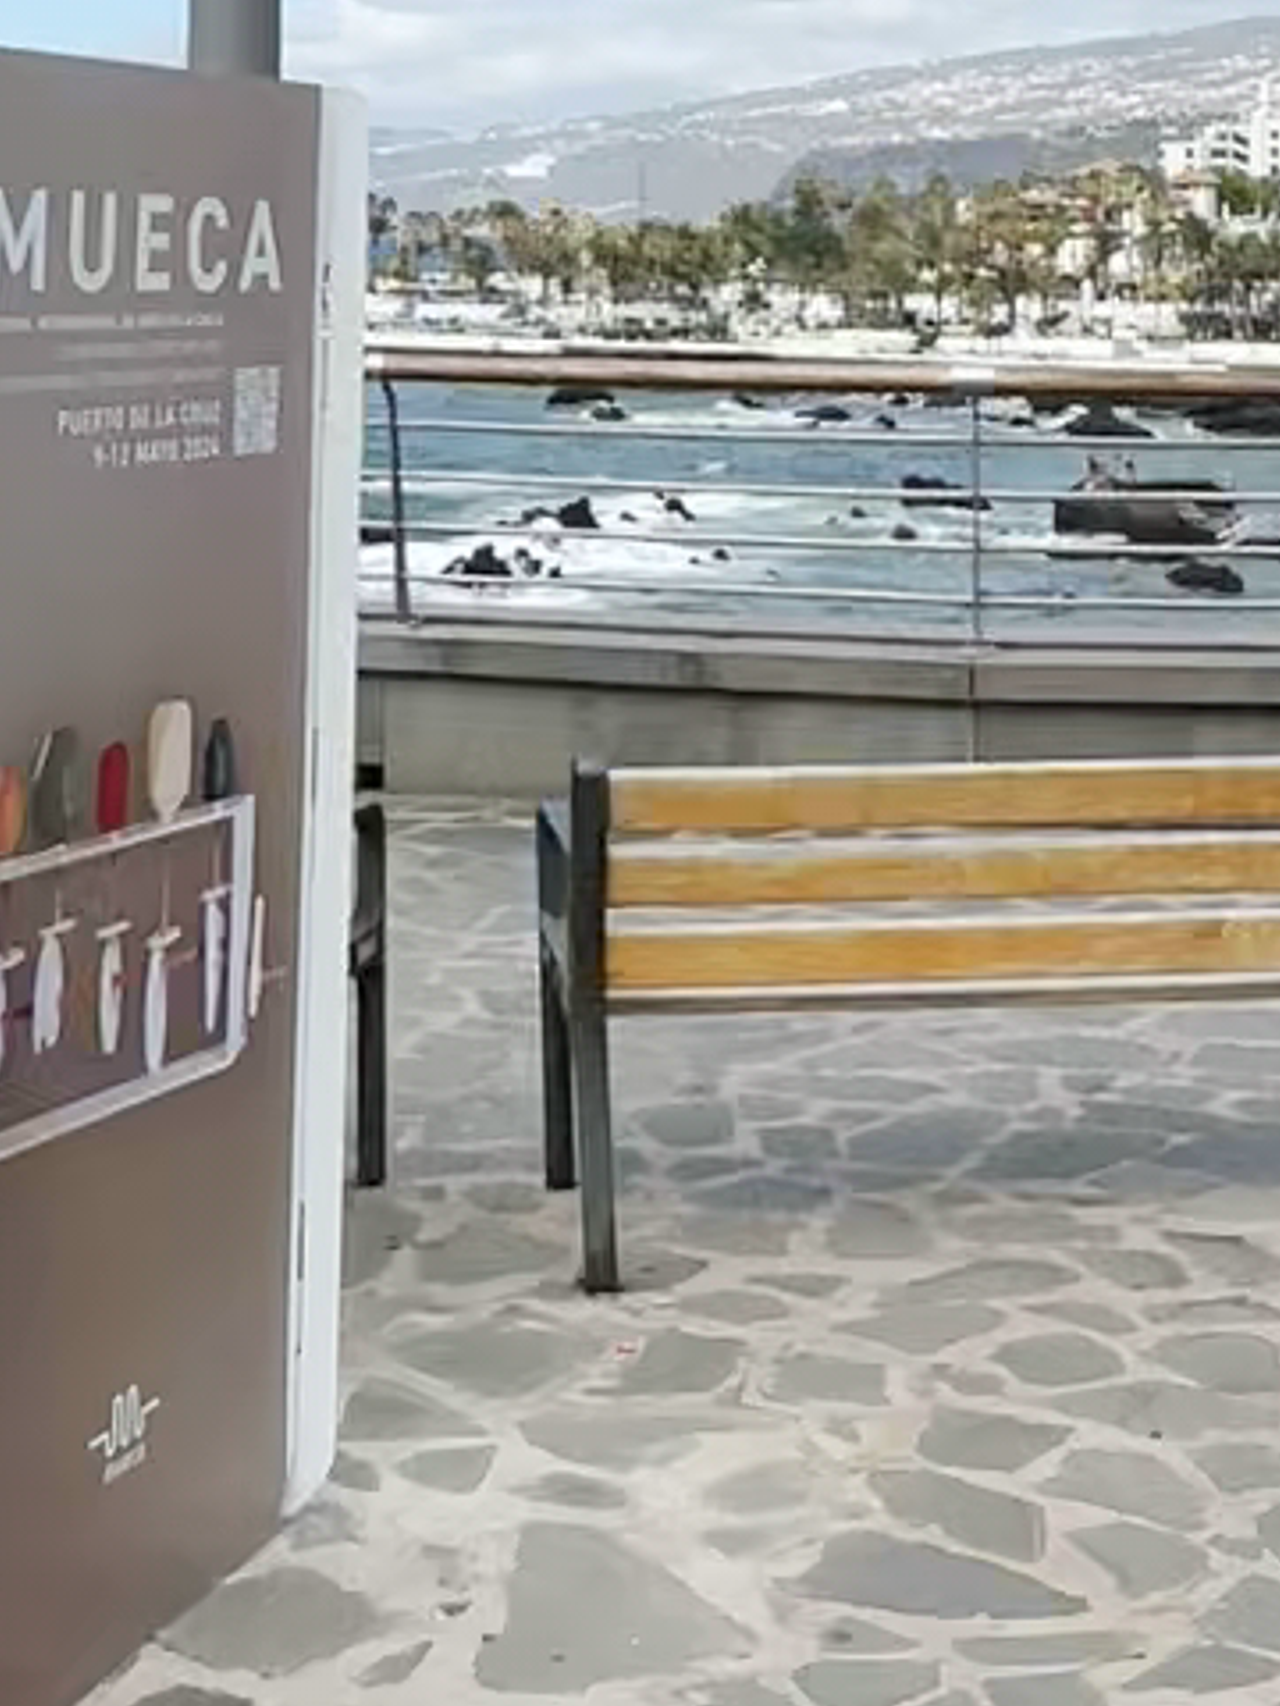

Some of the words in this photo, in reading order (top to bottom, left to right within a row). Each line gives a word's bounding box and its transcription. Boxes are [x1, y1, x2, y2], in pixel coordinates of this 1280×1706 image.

[58, 406, 123, 436] PUERTO
[129, 404, 149, 429] DE
[155, 403, 175, 429] LA
[179, 399, 221, 426] CRUZ
[135, 438, 178, 462] MAYO
